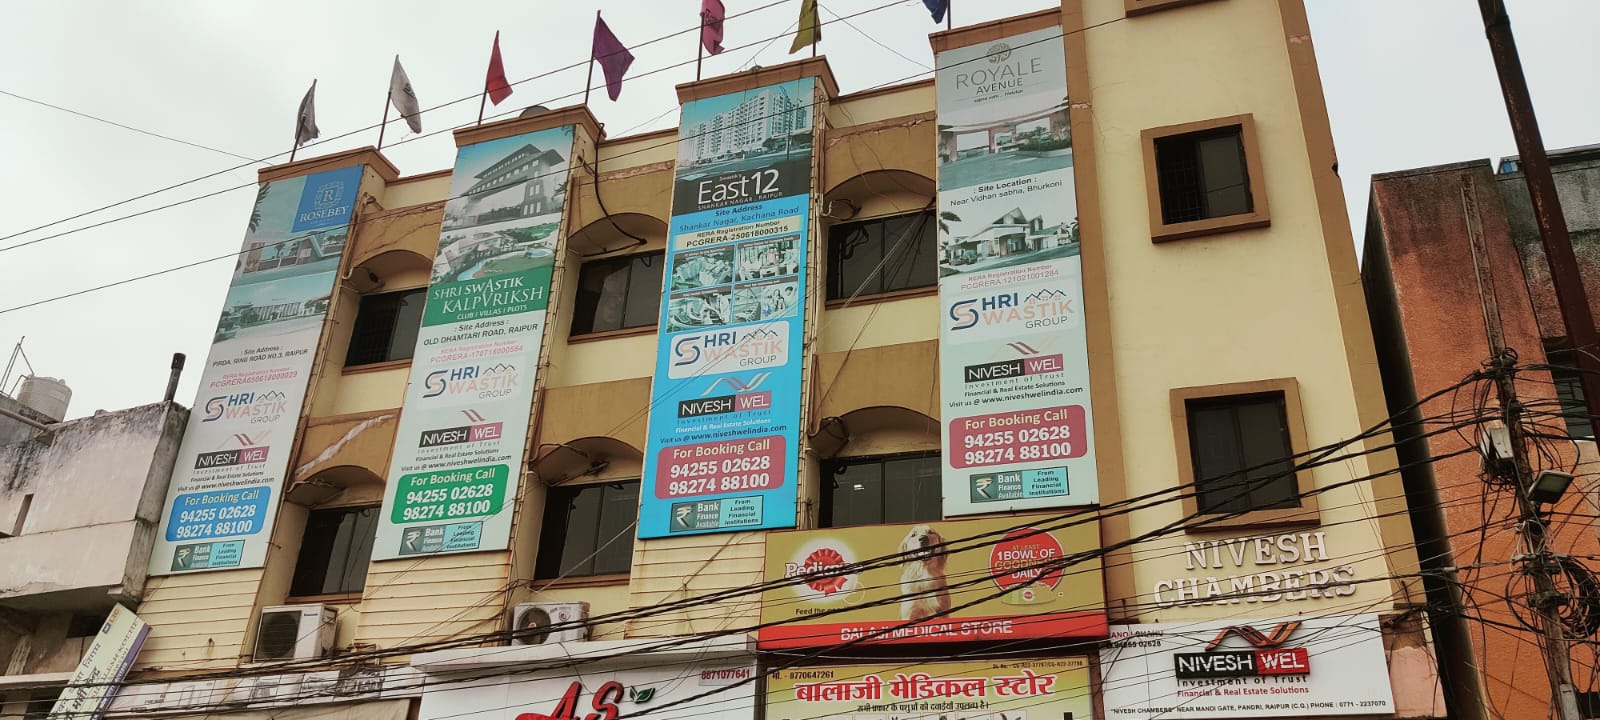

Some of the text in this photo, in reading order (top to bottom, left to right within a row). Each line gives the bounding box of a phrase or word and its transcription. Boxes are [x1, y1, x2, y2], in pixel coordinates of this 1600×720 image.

[956, 57, 1043, 89] ROYALE
[976, 78, 1023, 95] AVENUE
[950, 198, 968, 206] Near
[970, 192, 996, 202] Vidhan
[1027, 180, 1062, 192] Bhurkoni
[996, 178, 1032, 190] Location
[300, 206, 346, 222] ROSEBEY
[679, 220, 711, 232] Shankar
[741, 211, 776, 220] Kachana
[778, 206, 799, 216] Road
[715, 204, 762, 216] Site Address
[434, 276, 524, 300] SHRI SWASTIK
[442, 286, 544, 314] KALPVRIKSH
[476, 320, 505, 330] Address
[1025, 316, 1068, 328] GROUP
[424, 324, 539, 346] OLD DHAMTARI RAIPUR
[740, 355, 777, 366] GROUP
[968, 358, 1061, 380] NIVESH WEL
[478, 388, 512, 400] GROUP
[1035, 380, 1066, 389] Solutions
[682, 395, 769, 416] NIVESH WEL
[250, 415, 280, 424] GROUP
[675, 424, 702, 433] Financial
[965, 409, 1068, 430] For Booking Call
[422, 426, 499, 445] NIVESH WEL
[964, 425, 1070, 448] 94255 02628
[198, 450, 265, 467] NIVESH WEL
[674, 439, 770, 460] For Booking Call
[964, 442, 1072, 465] 98274 88100
[670, 456, 770, 478] 94255 02628
[410, 468, 496, 486] For Booking Call
[669, 473, 770, 495] 98274 88100
[998, 474, 1020, 484] Bank
[184, 490, 259, 506] For Booking Call
[406, 484, 493, 504] 94255 02628
[180, 504, 256, 523] 94255 02628
[402, 500, 491, 520] 98274 88100
[697, 502, 720, 512] Bank
[176, 520, 253, 539] 98274 88100
[425, 528, 444, 537] Bank
[194, 544, 210, 554] Bank
[1040, 548, 1056, 558] OF
[1184, 531, 1330, 570] NIVESH
[1012, 568, 1042, 578] DAILY
[1153, 566, 1356, 608] CHAMBERS
[892, 624, 958, 639] MEDICAL
[960, 620, 1013, 636] STORE
[1178, 652, 1305, 672] NIVESH WEL
[795, 670, 1056, 702] बालाजी मेडिकल स्टोर
[1177, 674, 1307, 687] Investment of Trust
[1177, 689, 1213, 698] Financial
[1223, 688, 1241, 696] Real
[1243, 687, 1268, 696] Estate
[1270, 686, 1309, 694] Solutions
